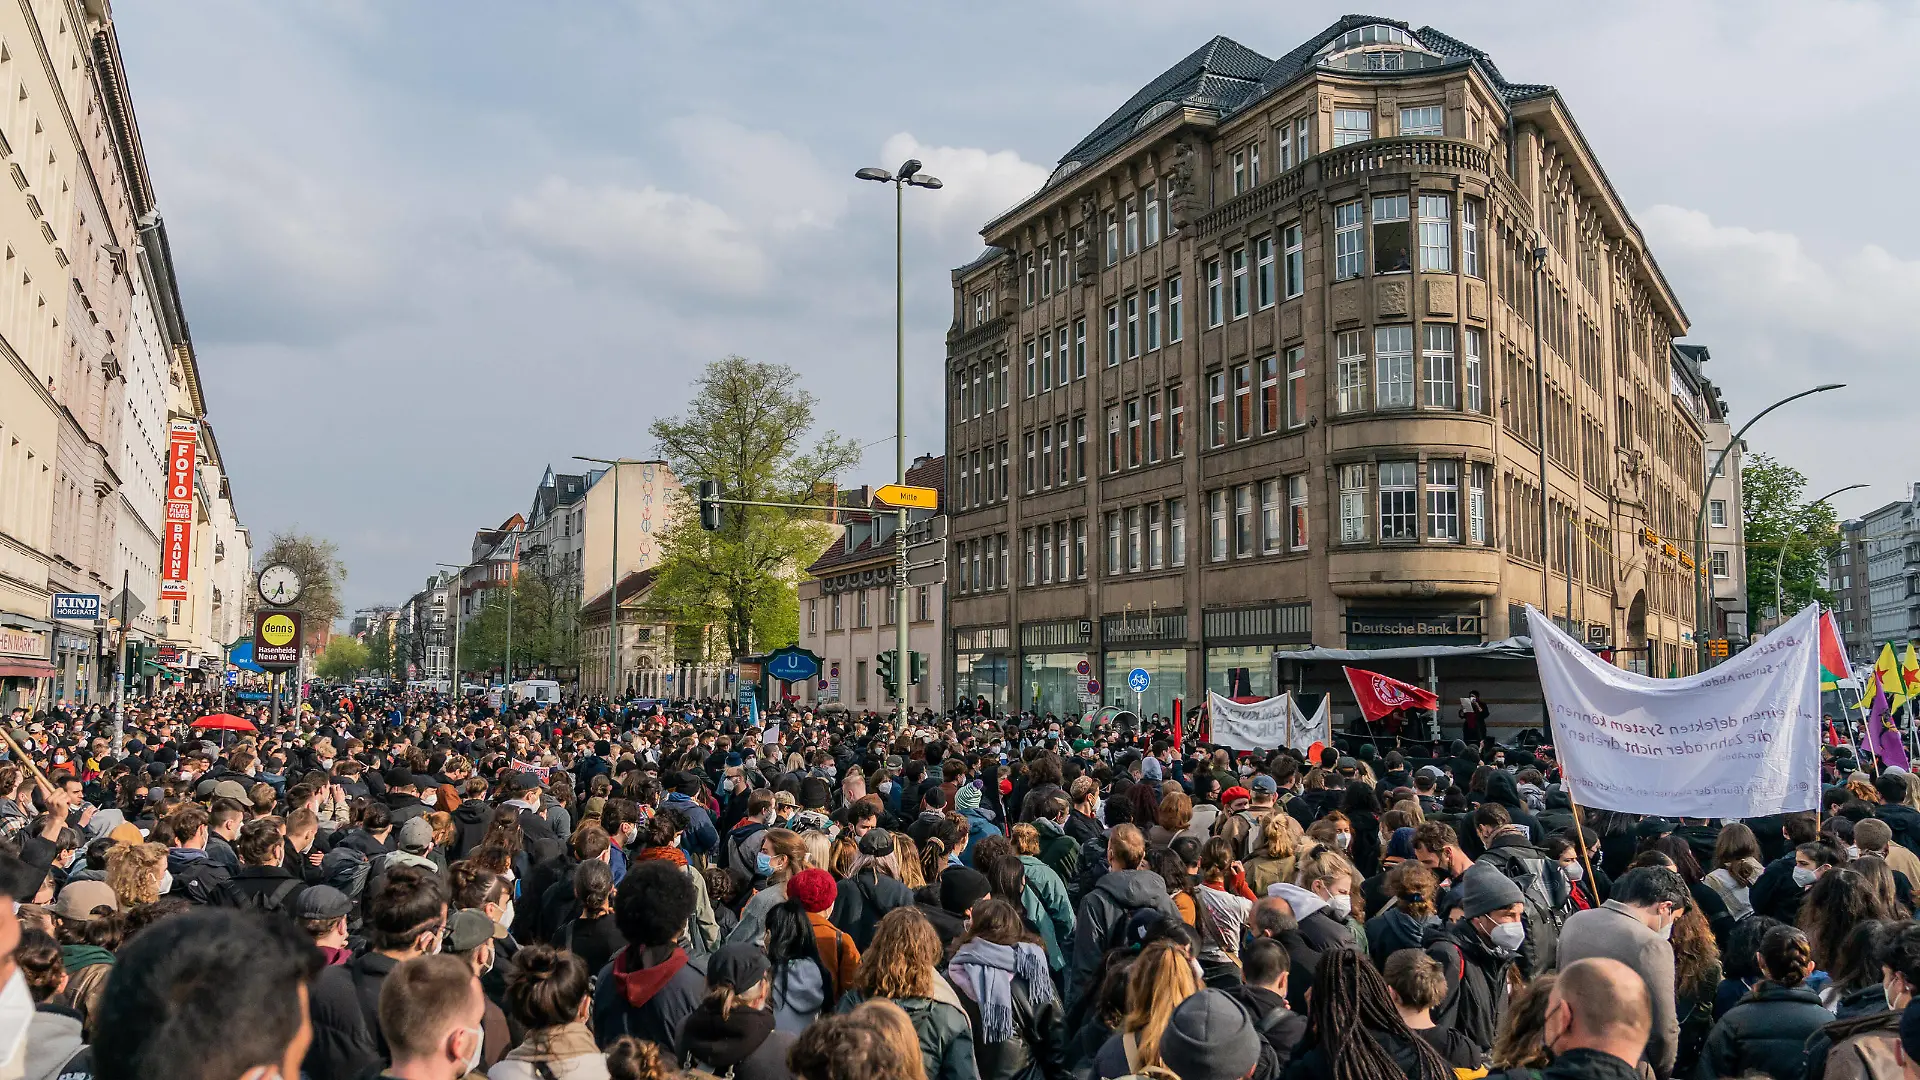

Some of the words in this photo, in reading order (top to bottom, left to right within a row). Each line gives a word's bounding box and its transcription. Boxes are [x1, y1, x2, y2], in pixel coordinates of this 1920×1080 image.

[173, 445, 189, 498] FOTO
[900, 492, 918, 501] Mitte
[171, 524, 183, 578] BRAUNE
[56, 597, 97, 609] KIND
[57, 608, 97, 616] HÖRGERÄTE
[265, 623, 293, 633] denns
[1351, 621, 1415, 635] Deutsche
[1417, 622, 1451, 635] Bank
[258, 646, 297, 654] Hasenheide
[278, 653, 296, 661] Welt
[788, 655, 798, 669] U
